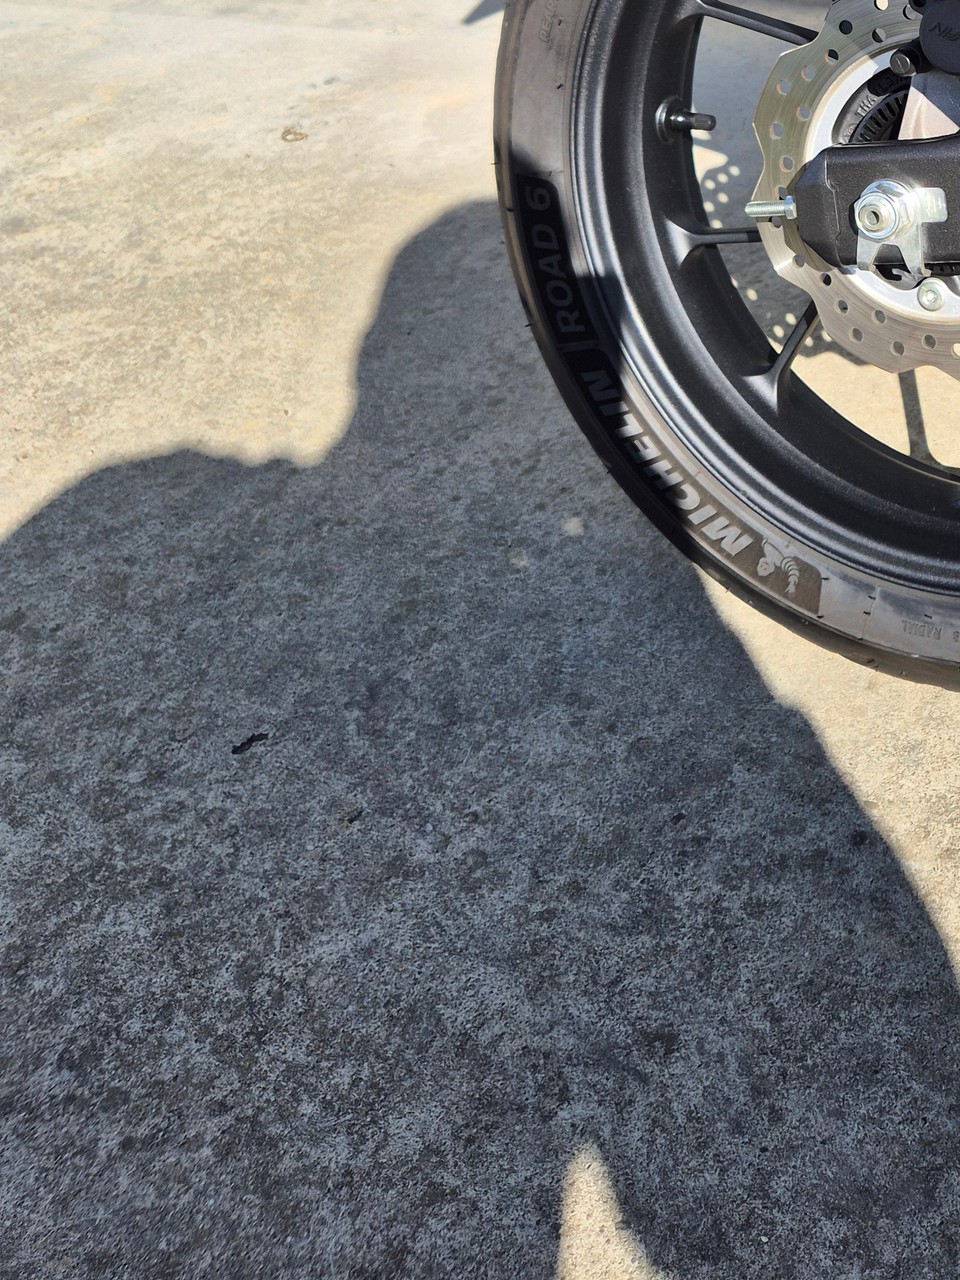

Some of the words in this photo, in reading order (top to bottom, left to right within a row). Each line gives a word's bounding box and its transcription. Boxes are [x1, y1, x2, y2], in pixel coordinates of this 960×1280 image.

[526, 186, 552, 210] 6
[531, 226, 586, 334] ROAD
[581, 369, 754, 557] MICHELIN
[900, 620, 941, 640] RADIAL
